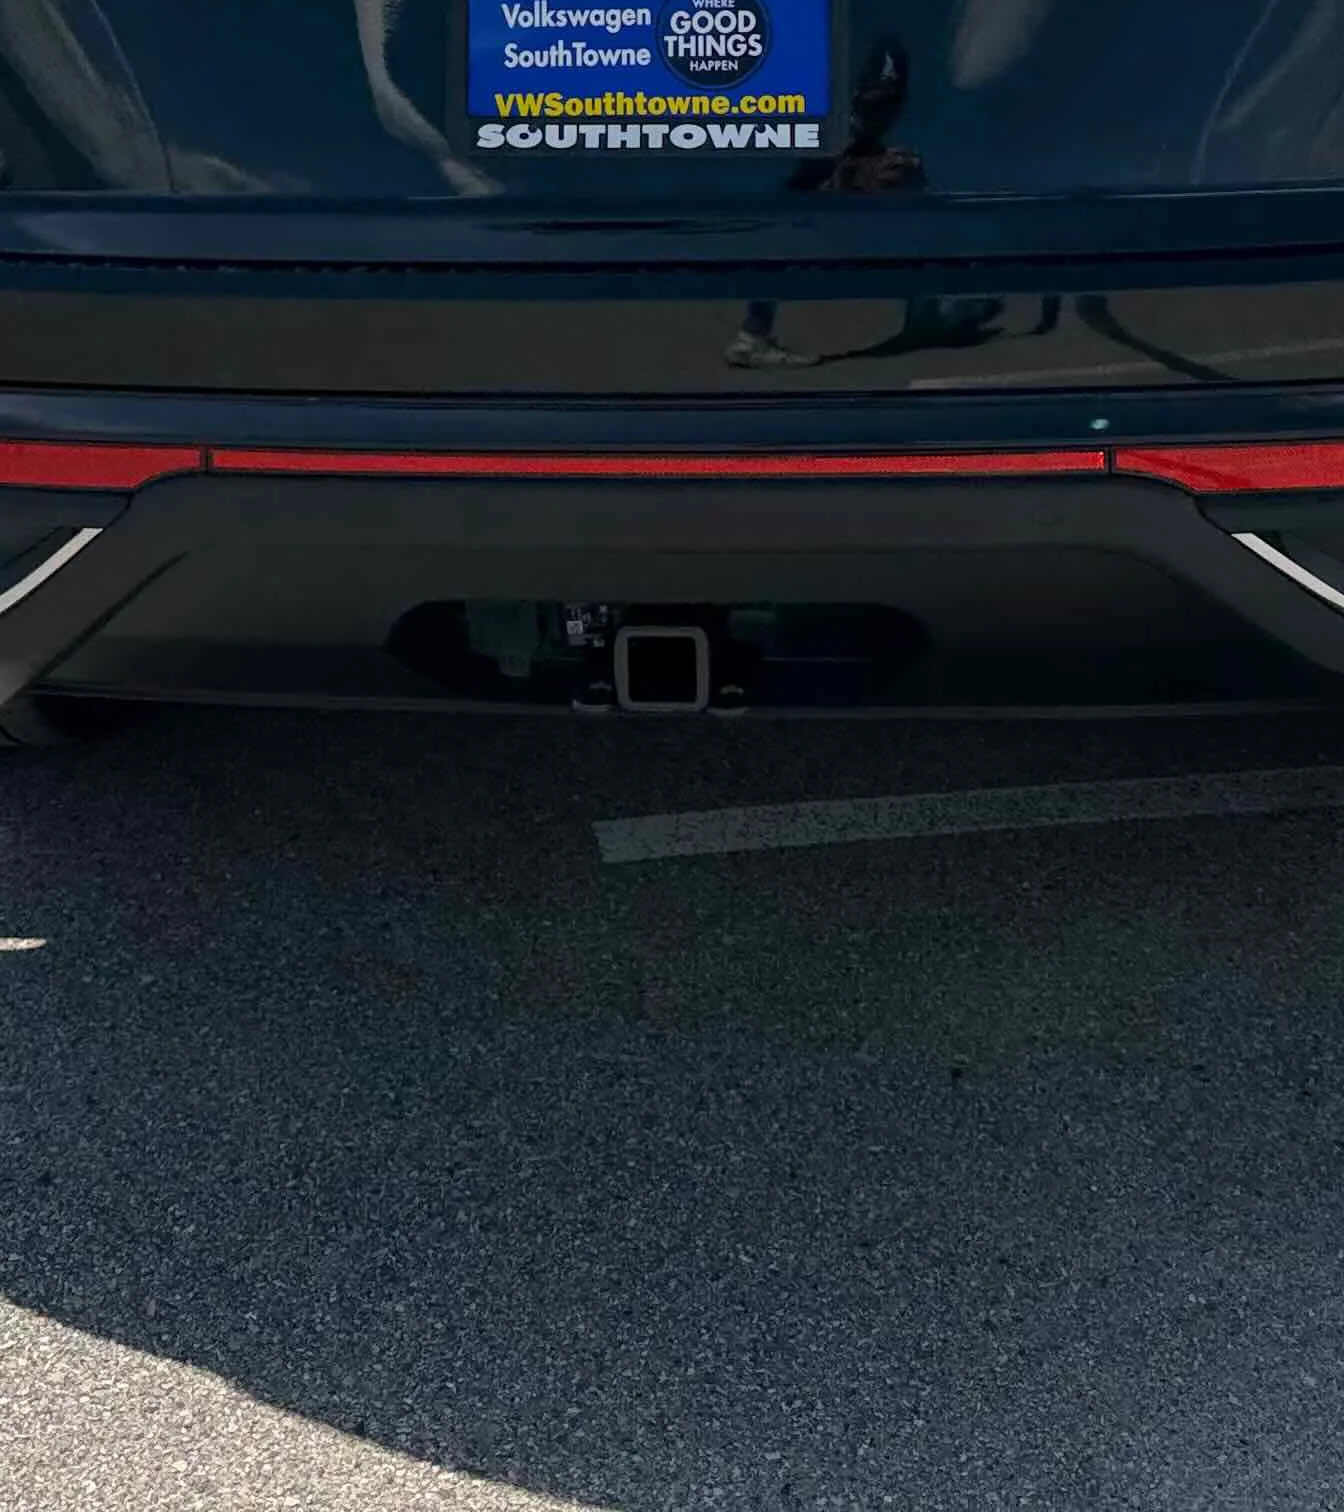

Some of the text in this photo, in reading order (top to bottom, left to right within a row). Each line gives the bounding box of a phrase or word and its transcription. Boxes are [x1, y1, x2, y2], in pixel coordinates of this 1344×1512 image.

[501, 0, 652, 33] Volkswagen
[670, 10, 756, 34] GOOD
[664, 34, 763, 58] THINGS
[689, 59, 739, 73] HAPPEN
[494, 90, 806, 118] VWSouthtowne.com
[476, 123, 820, 150] SOUTHTOWNE
